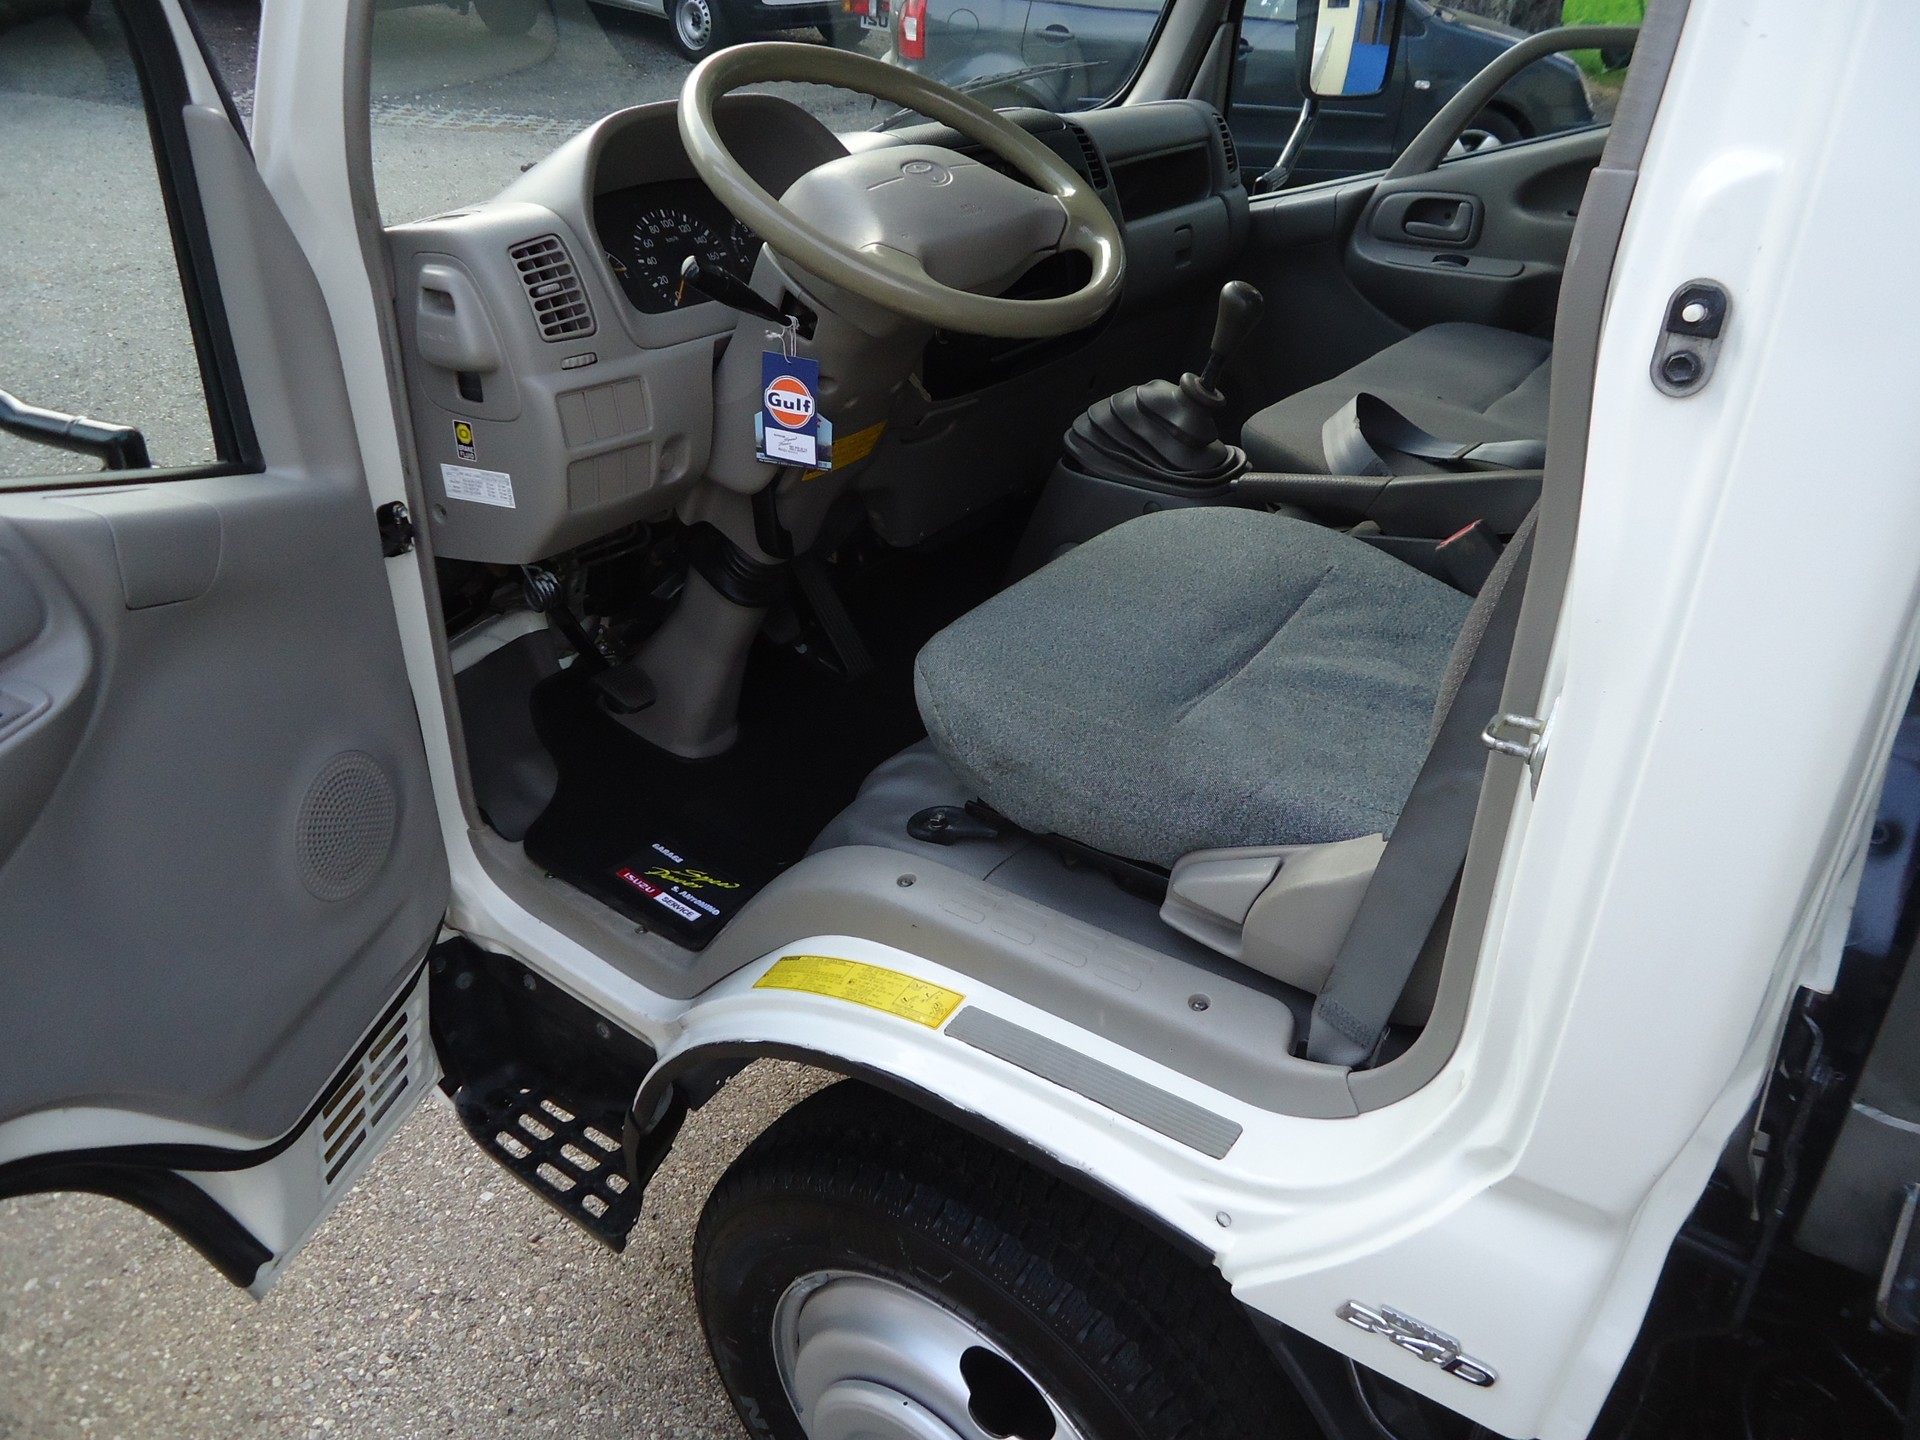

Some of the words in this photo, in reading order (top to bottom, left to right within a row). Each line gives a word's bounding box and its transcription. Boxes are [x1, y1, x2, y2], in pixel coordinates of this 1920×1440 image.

[660, 219, 674, 228] 100
[678, 223, 691, 233] 120
[649, 224, 660, 234] 80
[643, 238, 654, 249] 60
[694, 235, 707, 245] 140
[647, 256, 657, 265] 40
[707, 251, 720, 261] 160
[657, 275, 669, 284] 20
[767, 391, 811, 413] Gulf
[623, 872, 656, 893] ISUZU
[661, 896, 695, 918] SERVICE
